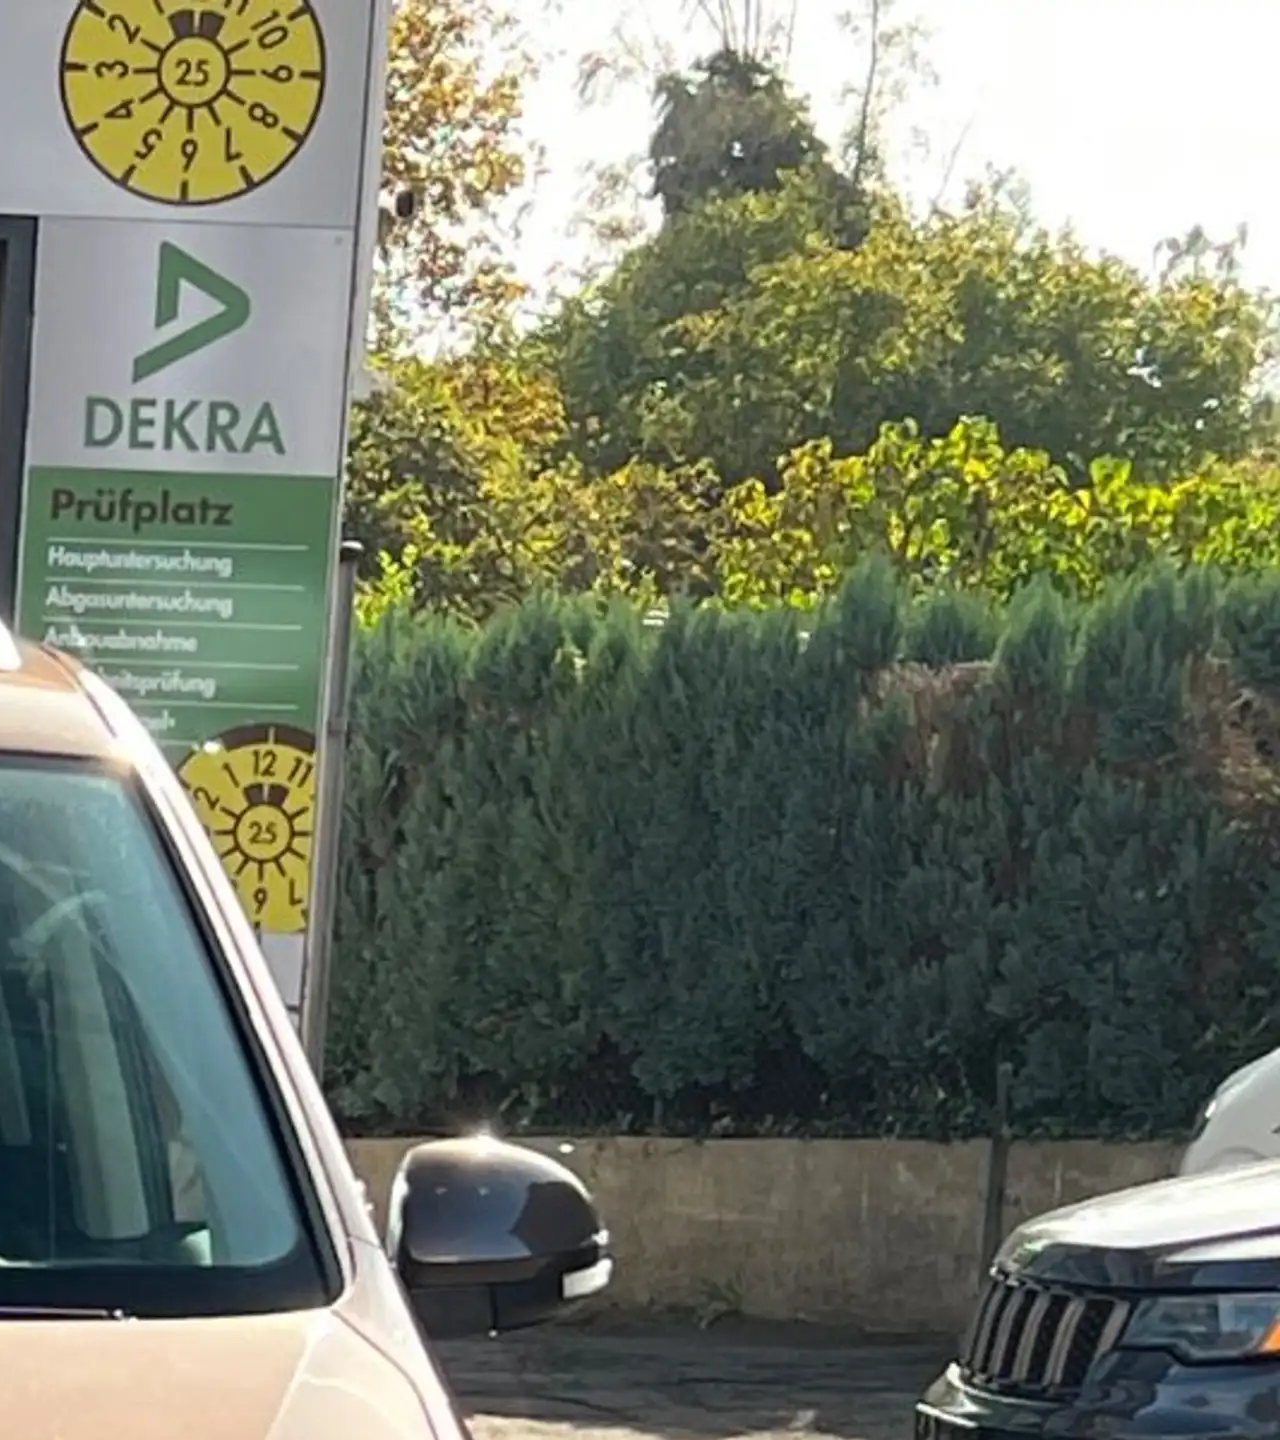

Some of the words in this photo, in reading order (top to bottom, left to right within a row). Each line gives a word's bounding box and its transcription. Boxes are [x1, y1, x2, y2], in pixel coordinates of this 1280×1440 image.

[108, 14, 140, 44] 2
[250, 9, 288, 49] 10
[94, 60, 129, 78] 3
[175, 58, 209, 86] 25
[104, 99, 134, 119] 4
[248, 103, 279, 128] 8
[134, 128, 163, 160] 5
[226, 128, 243, 163] 7
[83, 396, 286, 454] DEKRA
[50, 487, 234, 534] Prüfplatz
[48, 545, 233, 578] Hauptuntersuchung
[45, 585, 233, 618] Abgasuntersuchung
[222, 762, 240, 789] 1
[253, 750, 278, 777] 12
[287, 756, 313, 788] 11
[193, 786, 220, 811] 2
[248, 821, 277, 845] 25
